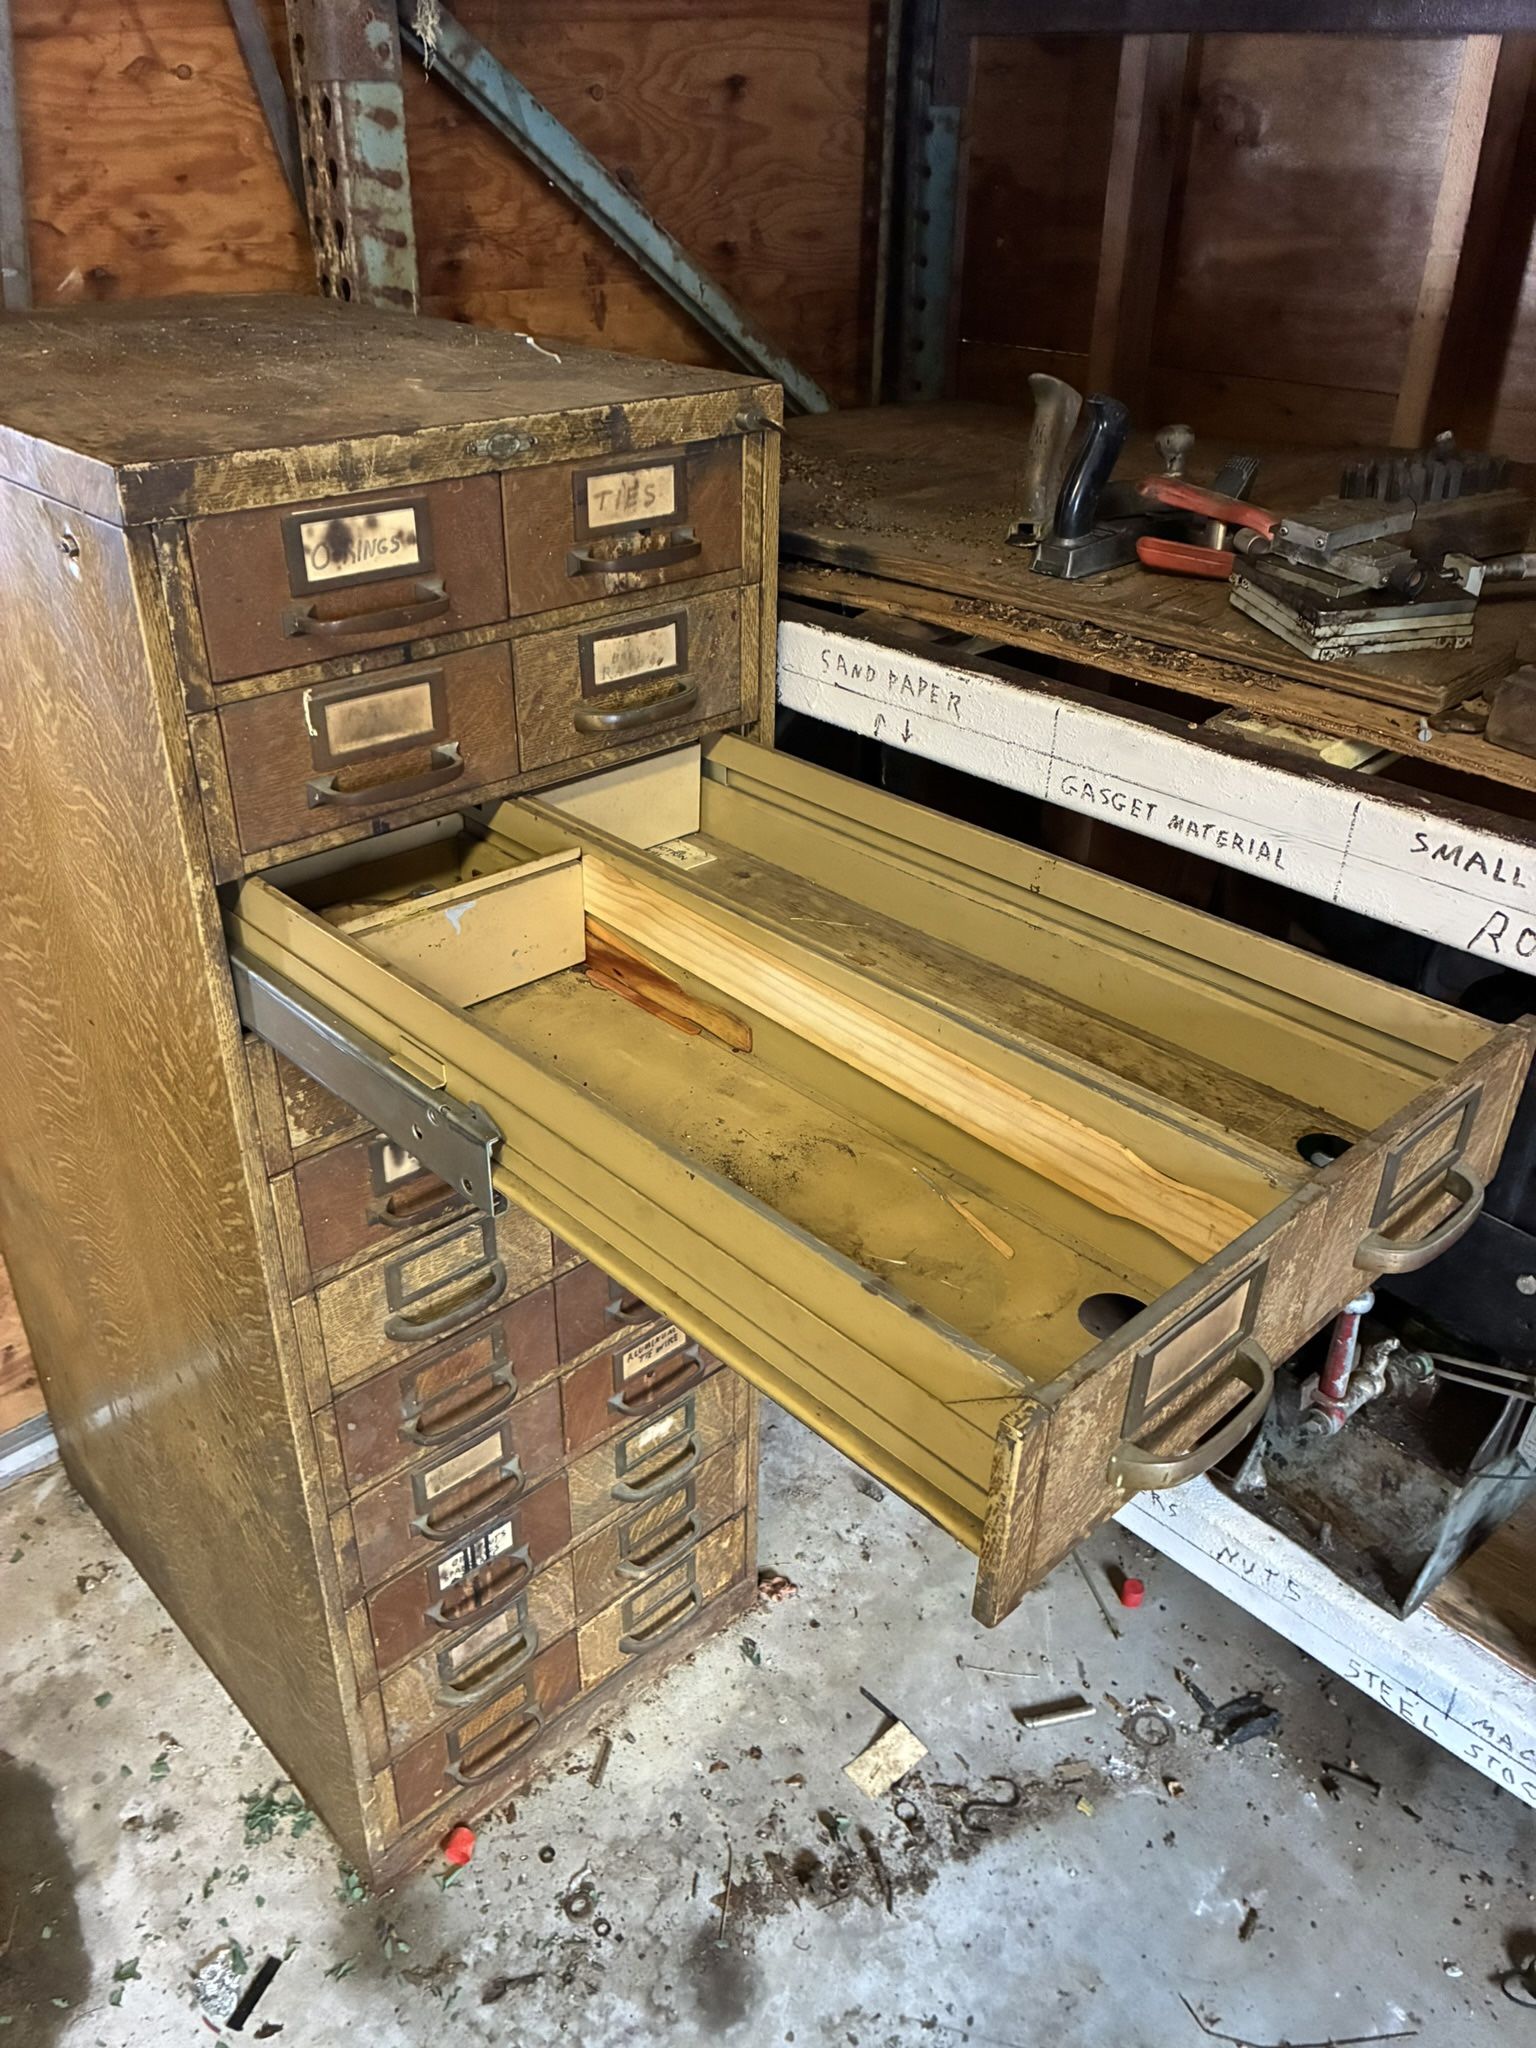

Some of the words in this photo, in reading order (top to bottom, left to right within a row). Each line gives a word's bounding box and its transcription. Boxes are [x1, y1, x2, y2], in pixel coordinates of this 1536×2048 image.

[593, 482, 656, 512] TIES
[820, 648, 876, 683] SAND
[888, 668, 961, 721] PAPER
[1061, 773, 1157, 822] GASGET
[1167, 812, 1286, 871] MATERIAL
[1410, 831, 1527, 889] SMALL
[1216, 1544, 1304, 1603] NUTS
[1344, 1657, 1438, 1738] STEEL
